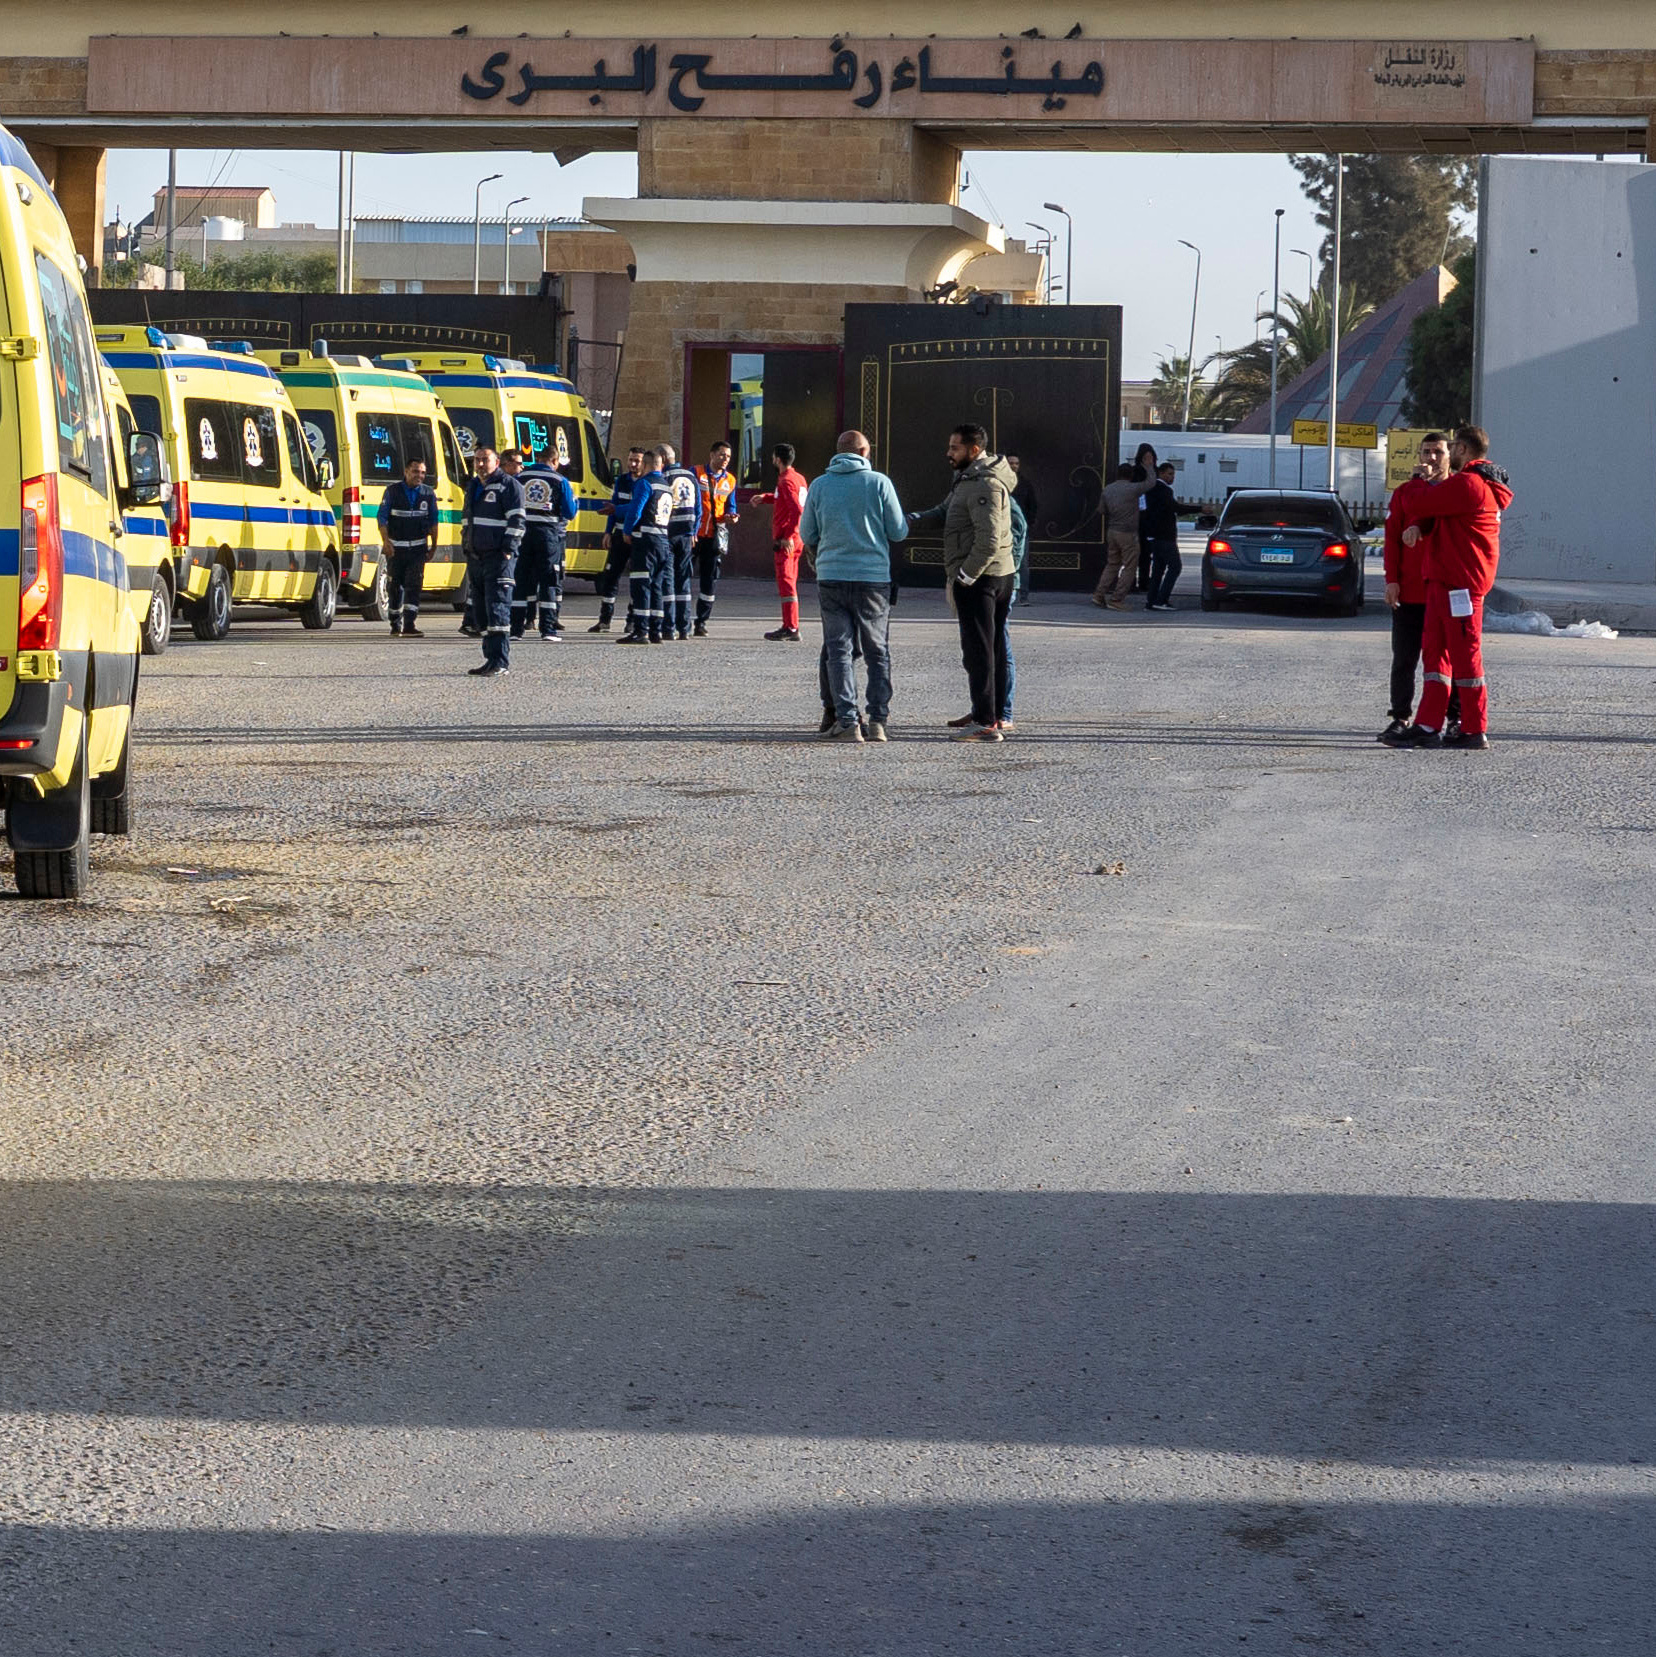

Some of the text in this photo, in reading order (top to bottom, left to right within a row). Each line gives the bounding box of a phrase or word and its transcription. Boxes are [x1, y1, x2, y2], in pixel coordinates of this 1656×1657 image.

[668, 38, 883, 112] رفح
[892, 42, 1105, 112] ميناء
[1384, 47, 1455, 70] وزارة النقل
